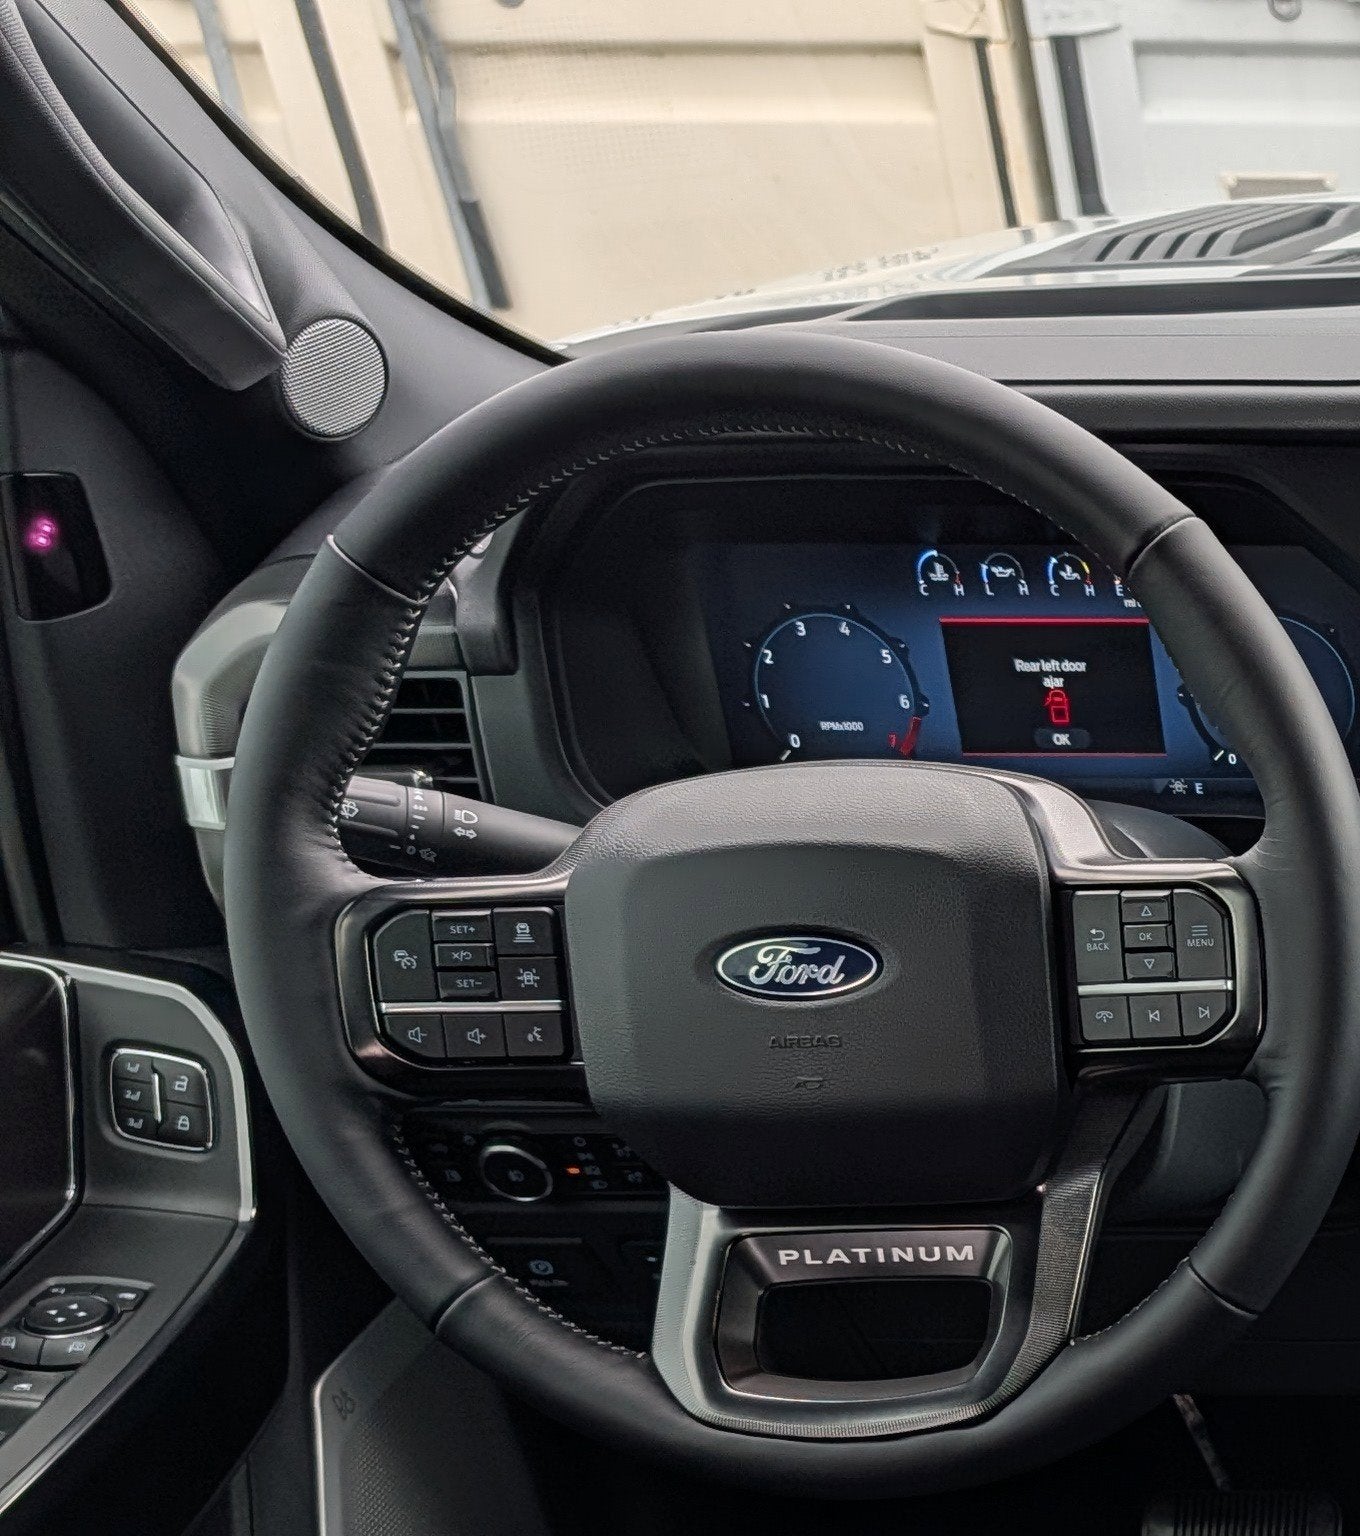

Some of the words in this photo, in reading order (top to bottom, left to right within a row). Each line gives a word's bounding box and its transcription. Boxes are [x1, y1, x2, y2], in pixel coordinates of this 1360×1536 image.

[954, 584, 964, 597] H
[1085, 584, 1095, 597] H
[795, 621, 806, 636] 3
[839, 621, 850, 636] 4
[762, 649, 774, 664] 2
[881, 649, 892, 664] 5
[1013, 658, 1040, 672] Rear
[1040, 658, 1061, 672] left
[1061, 659, 1087, 672] door
[1042, 675, 1065, 689] ajar
[761, 694, 770, 709] 1
[899, 694, 910, 709] 6
[788, 733, 801, 748] 0
[1052, 733, 1071, 745] OK
[1227, 753, 1237, 765] 0
[1195, 782, 1204, 795] E
[1139, 932, 1152, 941] OK
[1186, 938, 1215, 947] MENU
[1086, 942, 1110, 952] BACK
[749, 943, 846, 986] Ford
[768, 1034, 843, 1049] AIRBAG
[777, 1243, 976, 1267] PLATINUM
